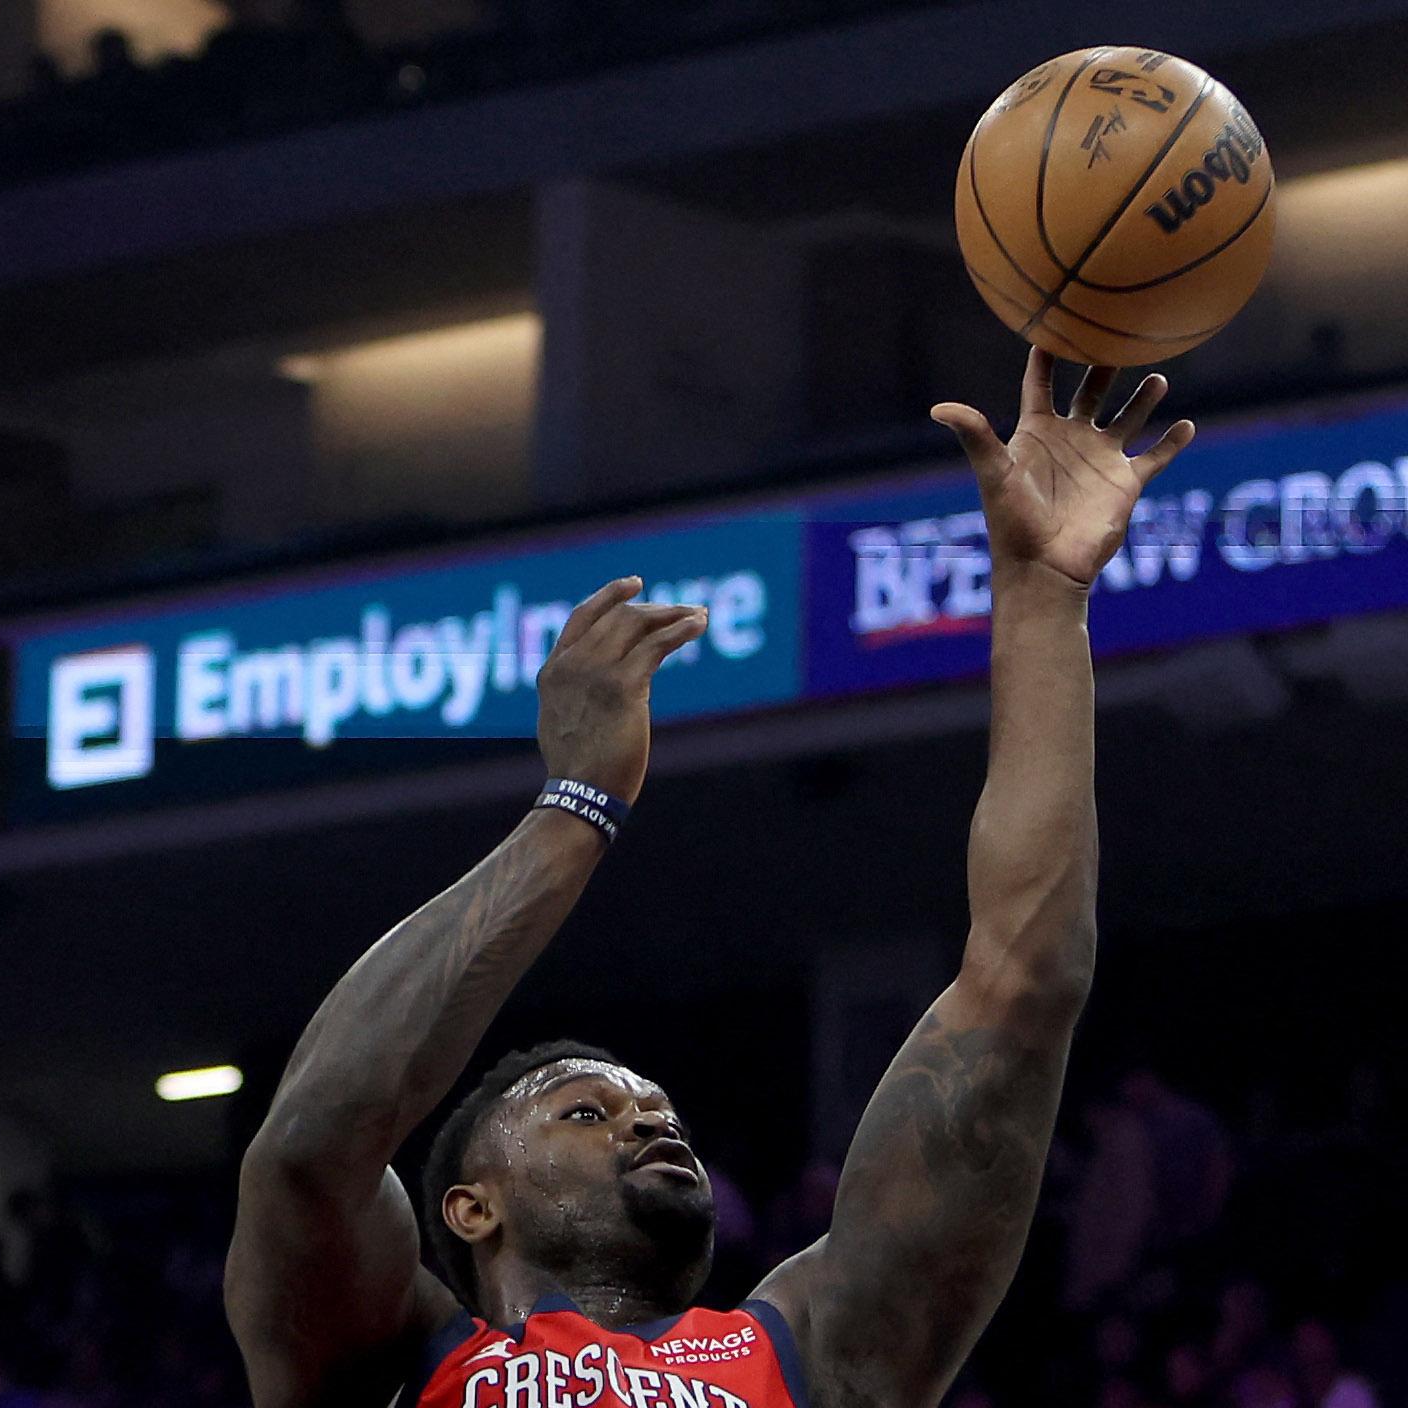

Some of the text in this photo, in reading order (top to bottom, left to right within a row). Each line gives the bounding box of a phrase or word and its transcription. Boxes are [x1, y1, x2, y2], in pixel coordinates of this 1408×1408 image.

[174, 568, 767, 748] EmployInre
[558, 779, 608, 807] D'EVILS
[560, 795, 578, 811] TO
[650, 1326, 756, 1357] NEWAGE
[665, 1346, 751, 1365] PRODUCTS
